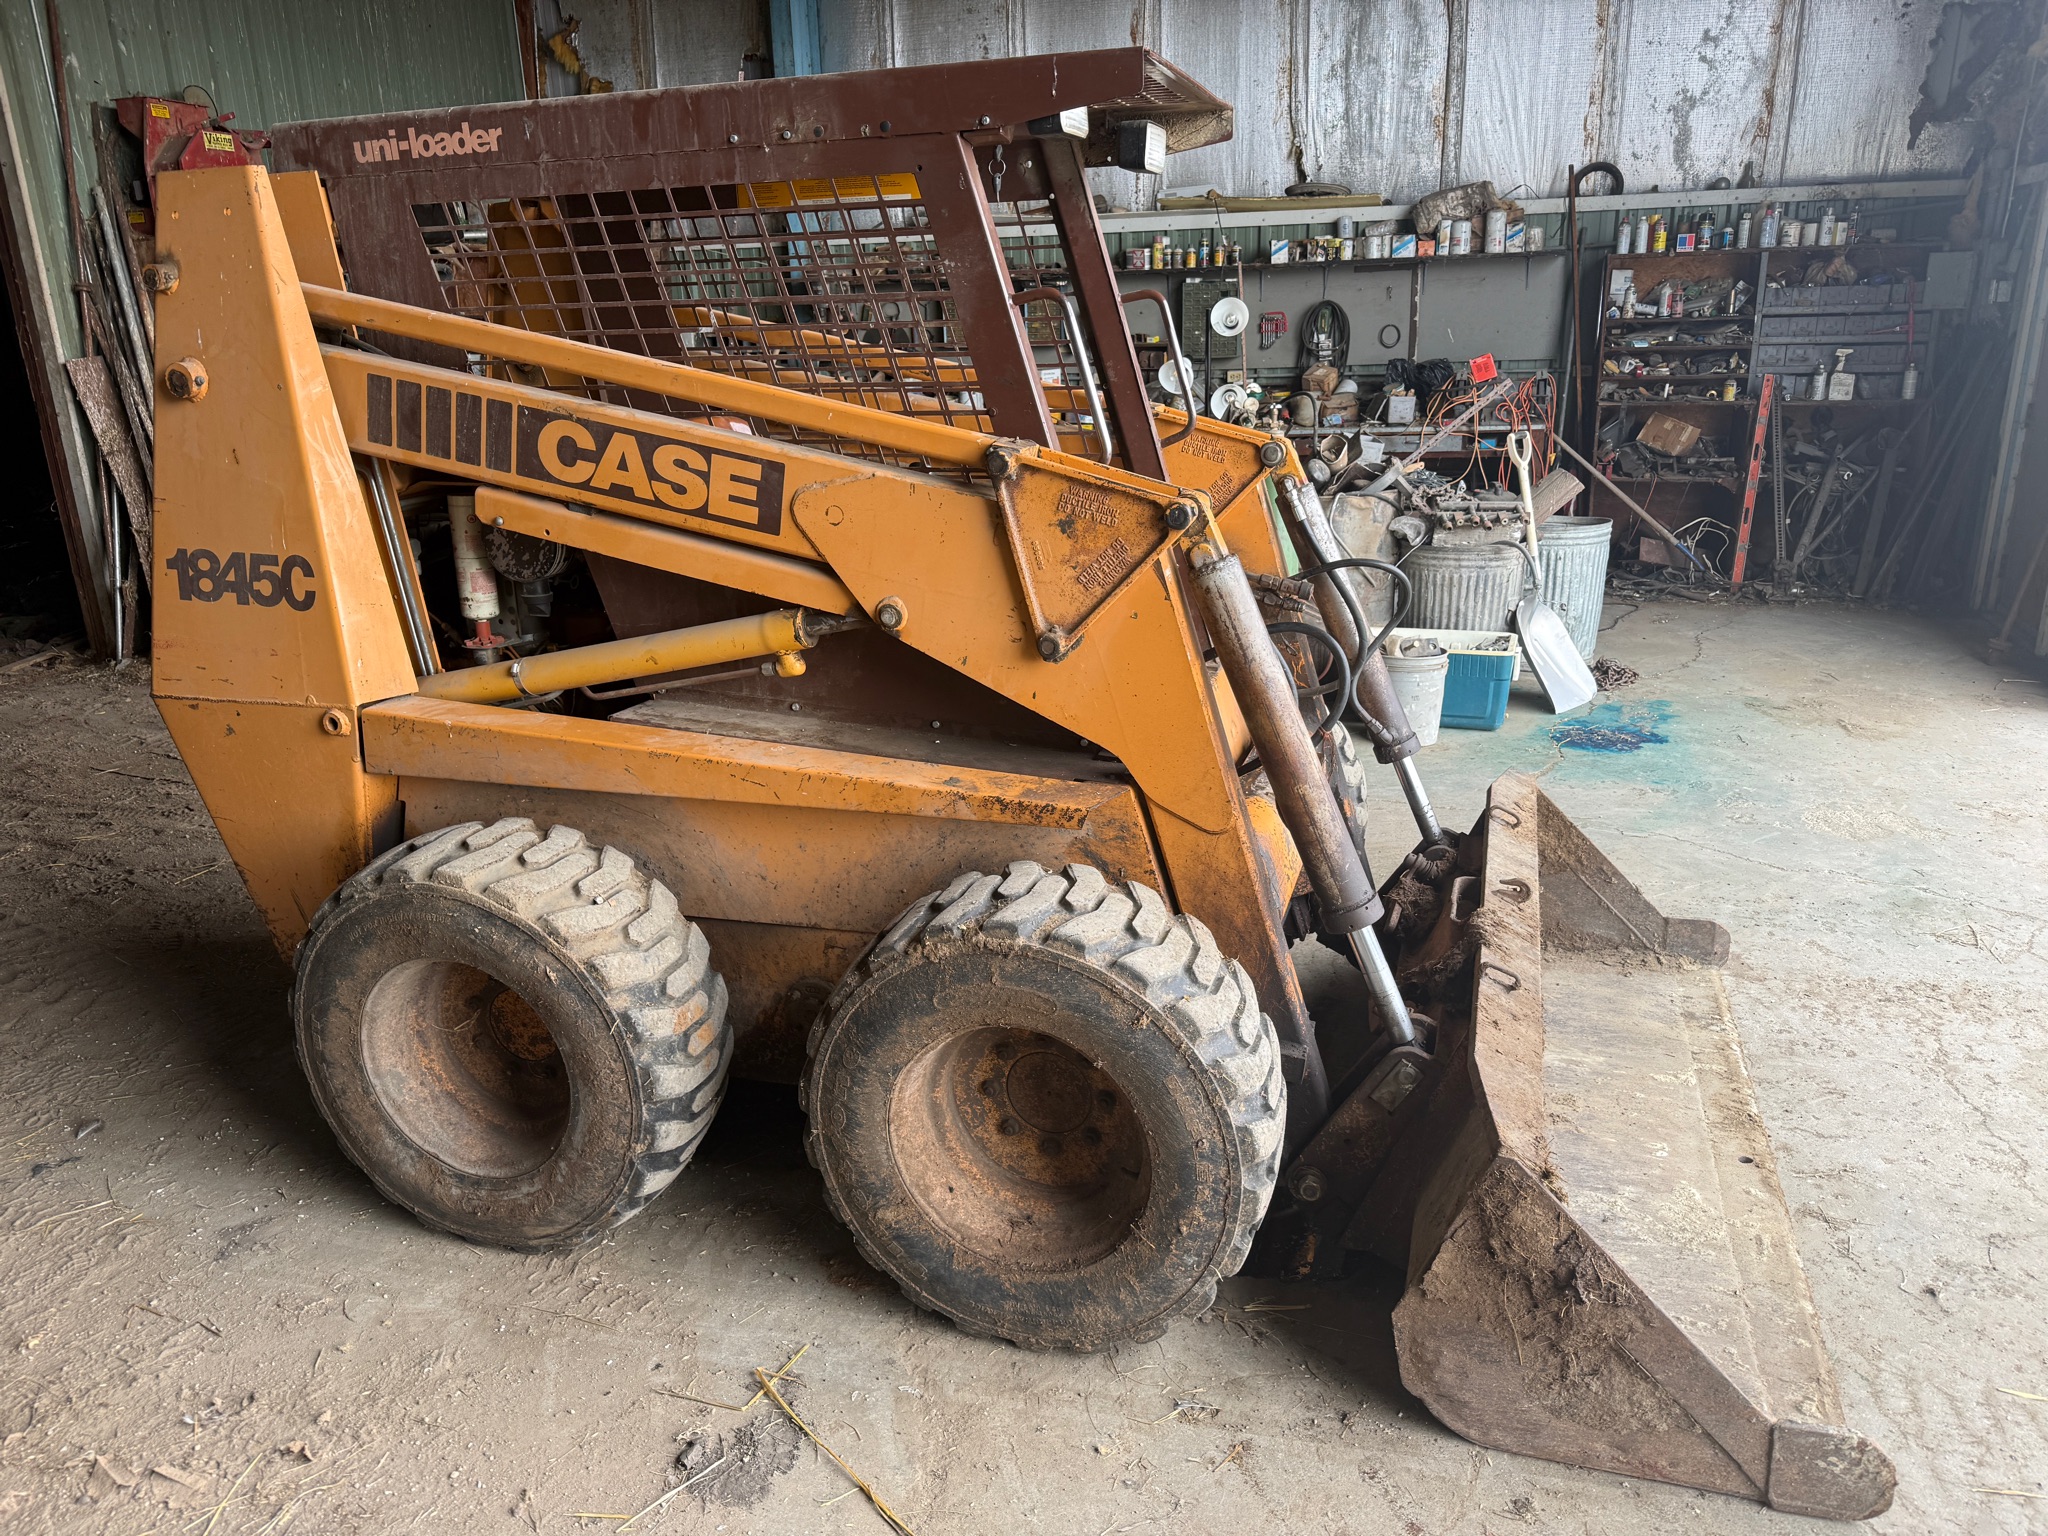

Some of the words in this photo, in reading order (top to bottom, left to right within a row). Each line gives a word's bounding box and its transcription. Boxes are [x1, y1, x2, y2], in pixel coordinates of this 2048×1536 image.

[204, 132, 233, 147] Viking
[353, 122, 502, 164] uni-loader
[537, 419, 762, 525] CASE
[1060, 493, 1098, 510] DUCTILE
[1098, 504, 1120, 518] IRON
[1069, 485, 1111, 505] WARNING
[1057, 501, 1071, 514] DO
[1072, 506, 1092, 520] NOT
[1091, 511, 1119, 527] WELD
[1111, 536, 1125, 550] DO
[1096, 548, 1114, 564] NOT
[1099, 544, 1130, 575] DUCTILE
[166, 547, 317, 612] 1845C
[1077, 562, 1101, 584] WELD
